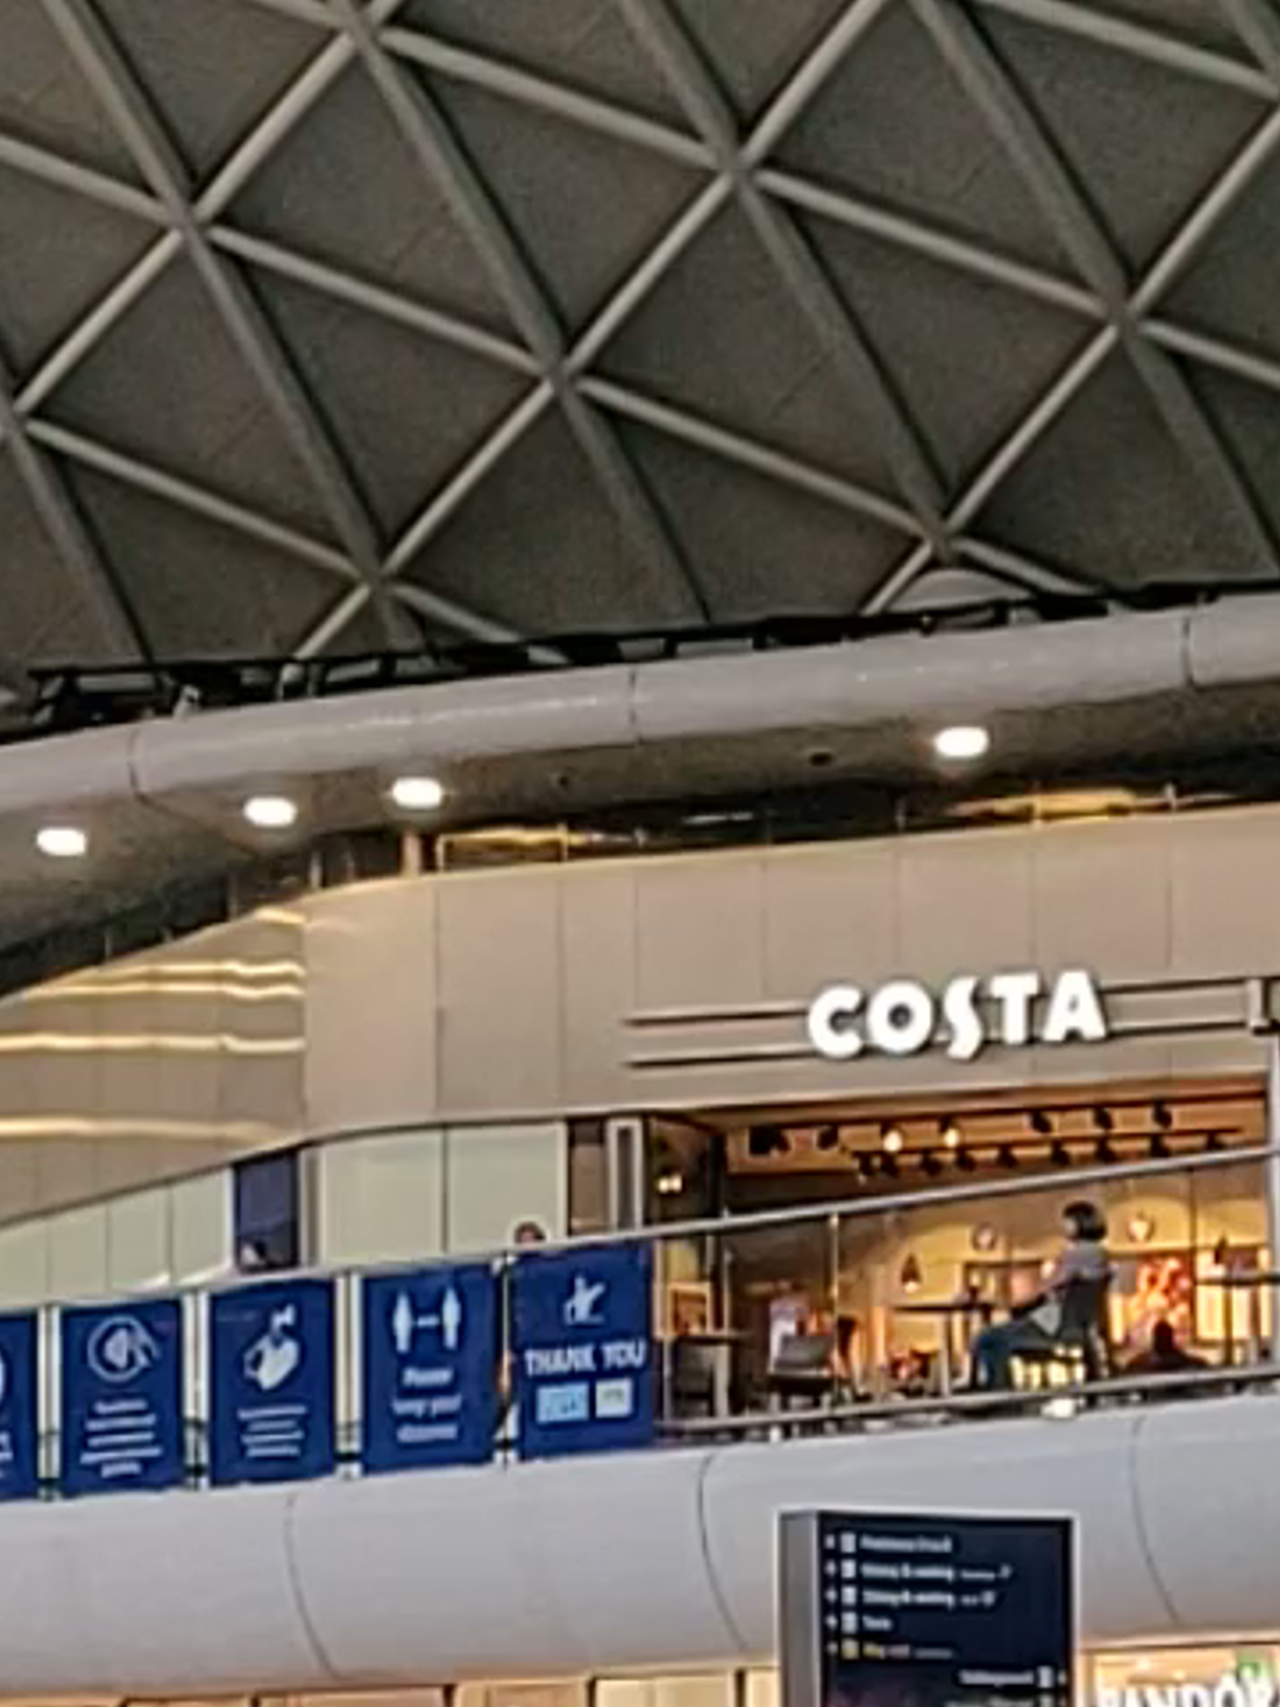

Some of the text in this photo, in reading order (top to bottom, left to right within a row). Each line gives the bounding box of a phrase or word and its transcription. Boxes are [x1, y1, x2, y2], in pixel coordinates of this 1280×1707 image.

[807, 968, 1107, 1060] COSTA
[524, 1338, 648, 1377] THANK YOU
